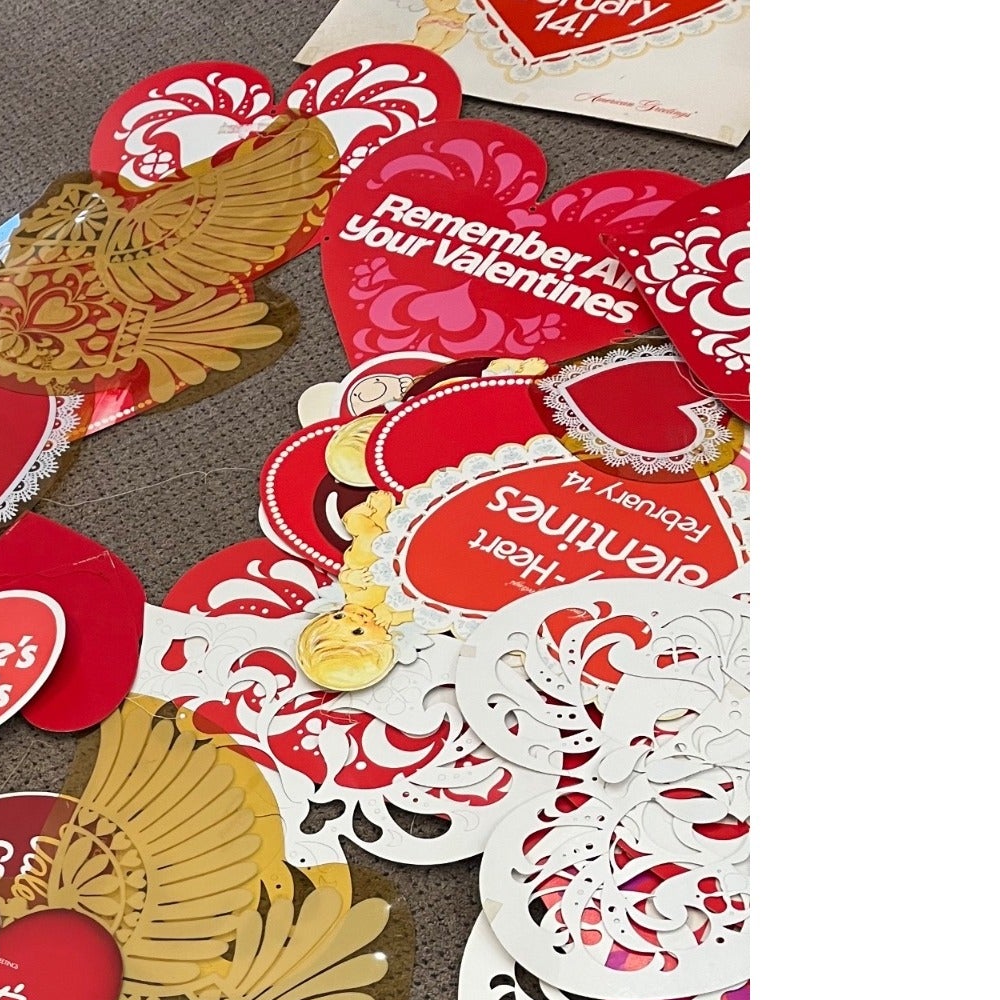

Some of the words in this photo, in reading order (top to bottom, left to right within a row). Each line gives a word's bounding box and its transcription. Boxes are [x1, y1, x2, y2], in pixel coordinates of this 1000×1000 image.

[533, 7, 599, 38] 14!
[372, 193, 592, 273] Remember
[339, 214, 435, 258] your
[432, 238, 640, 325] Valentines
[561, 470, 594, 494] 14
[596, 481, 712, 544] February
[467, 529, 566, 586] -Heart
[485, 485, 710, 588] alentines
